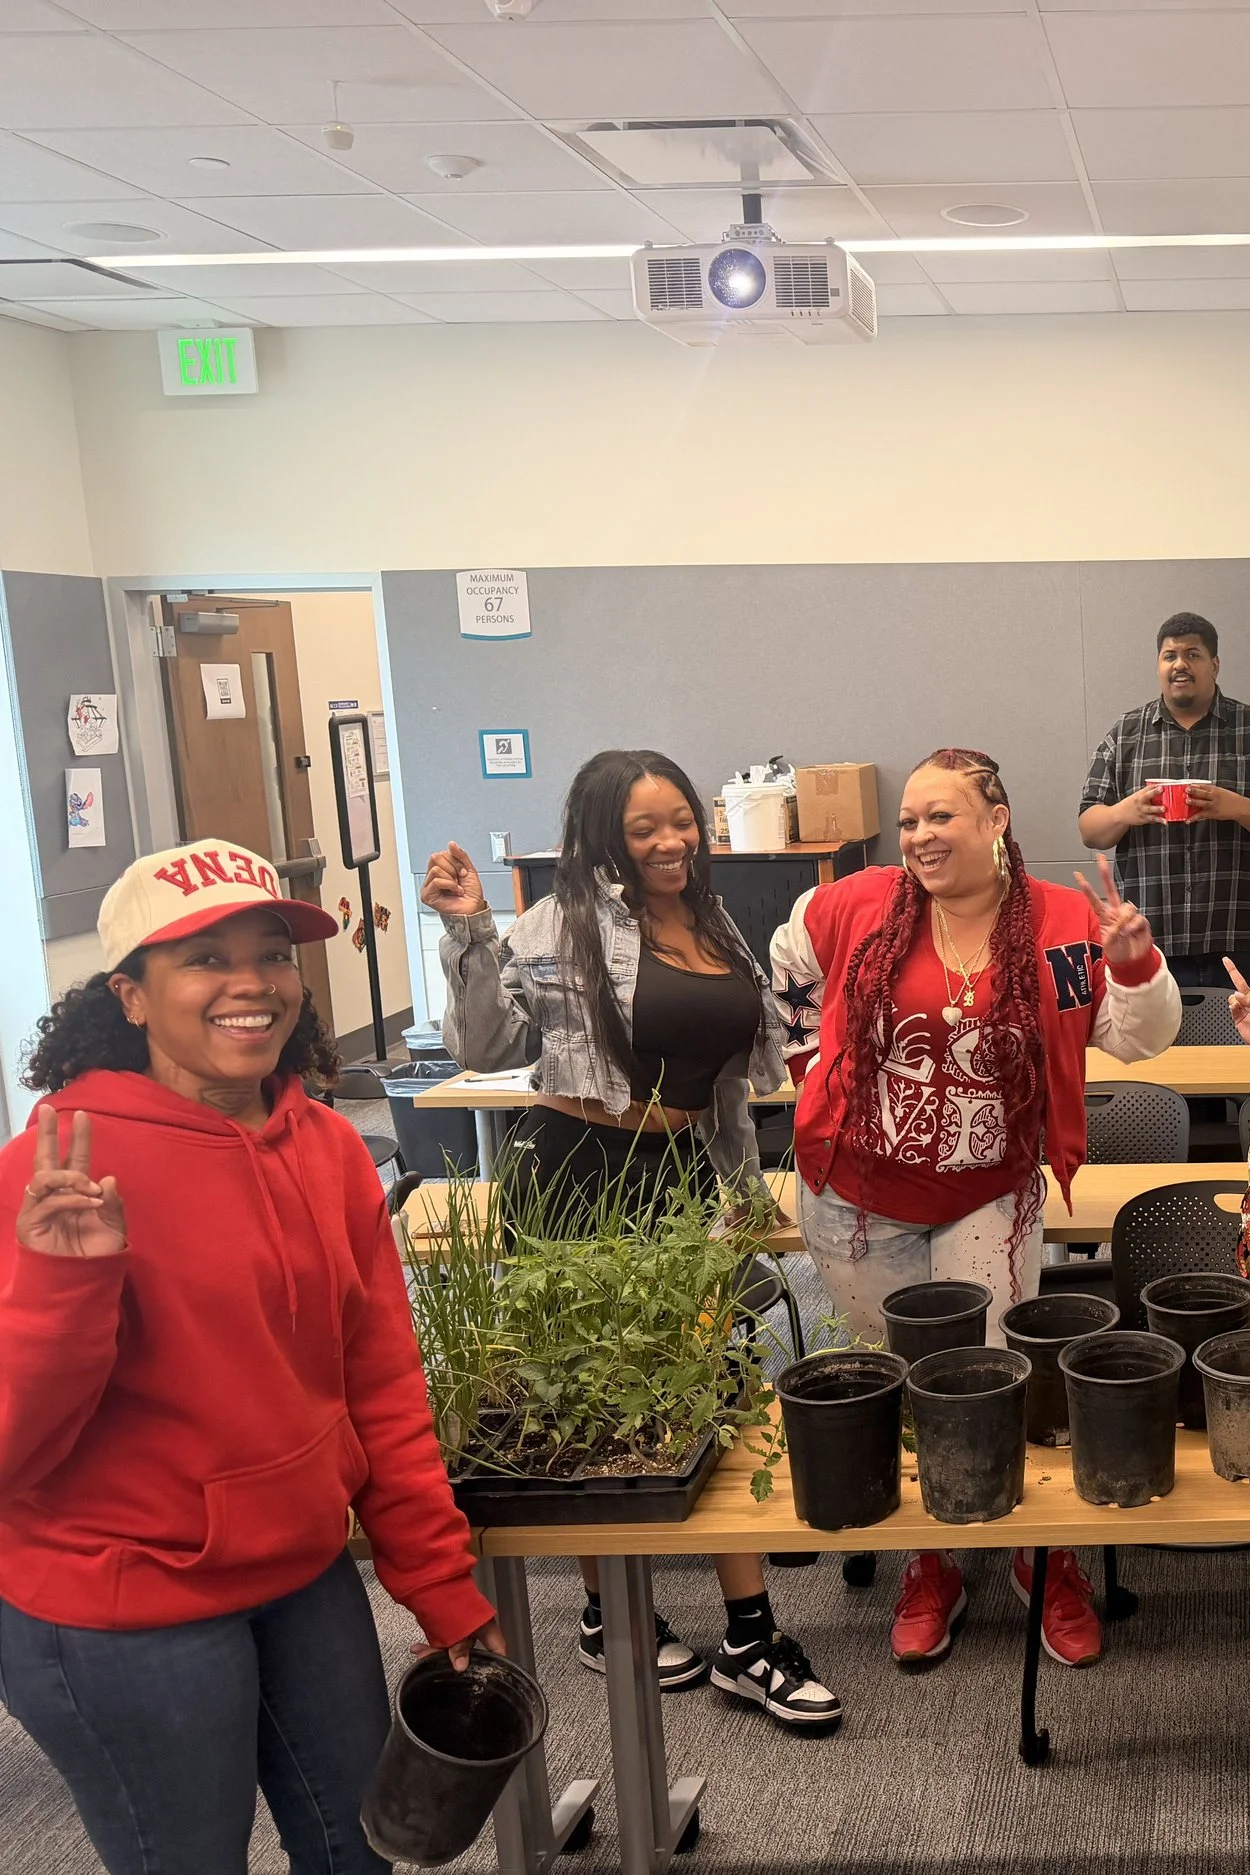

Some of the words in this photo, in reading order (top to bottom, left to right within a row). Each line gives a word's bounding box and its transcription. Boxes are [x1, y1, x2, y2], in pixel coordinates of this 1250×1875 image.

[177, 338, 238, 385] EXIT
[470, 574, 514, 583] MAXIMUM
[466, 586, 519, 595] OCCUPANCY
[484, 597, 503, 612] 67
[475, 615, 515, 624] PERSONS
[153, 850, 279, 900] DENA
